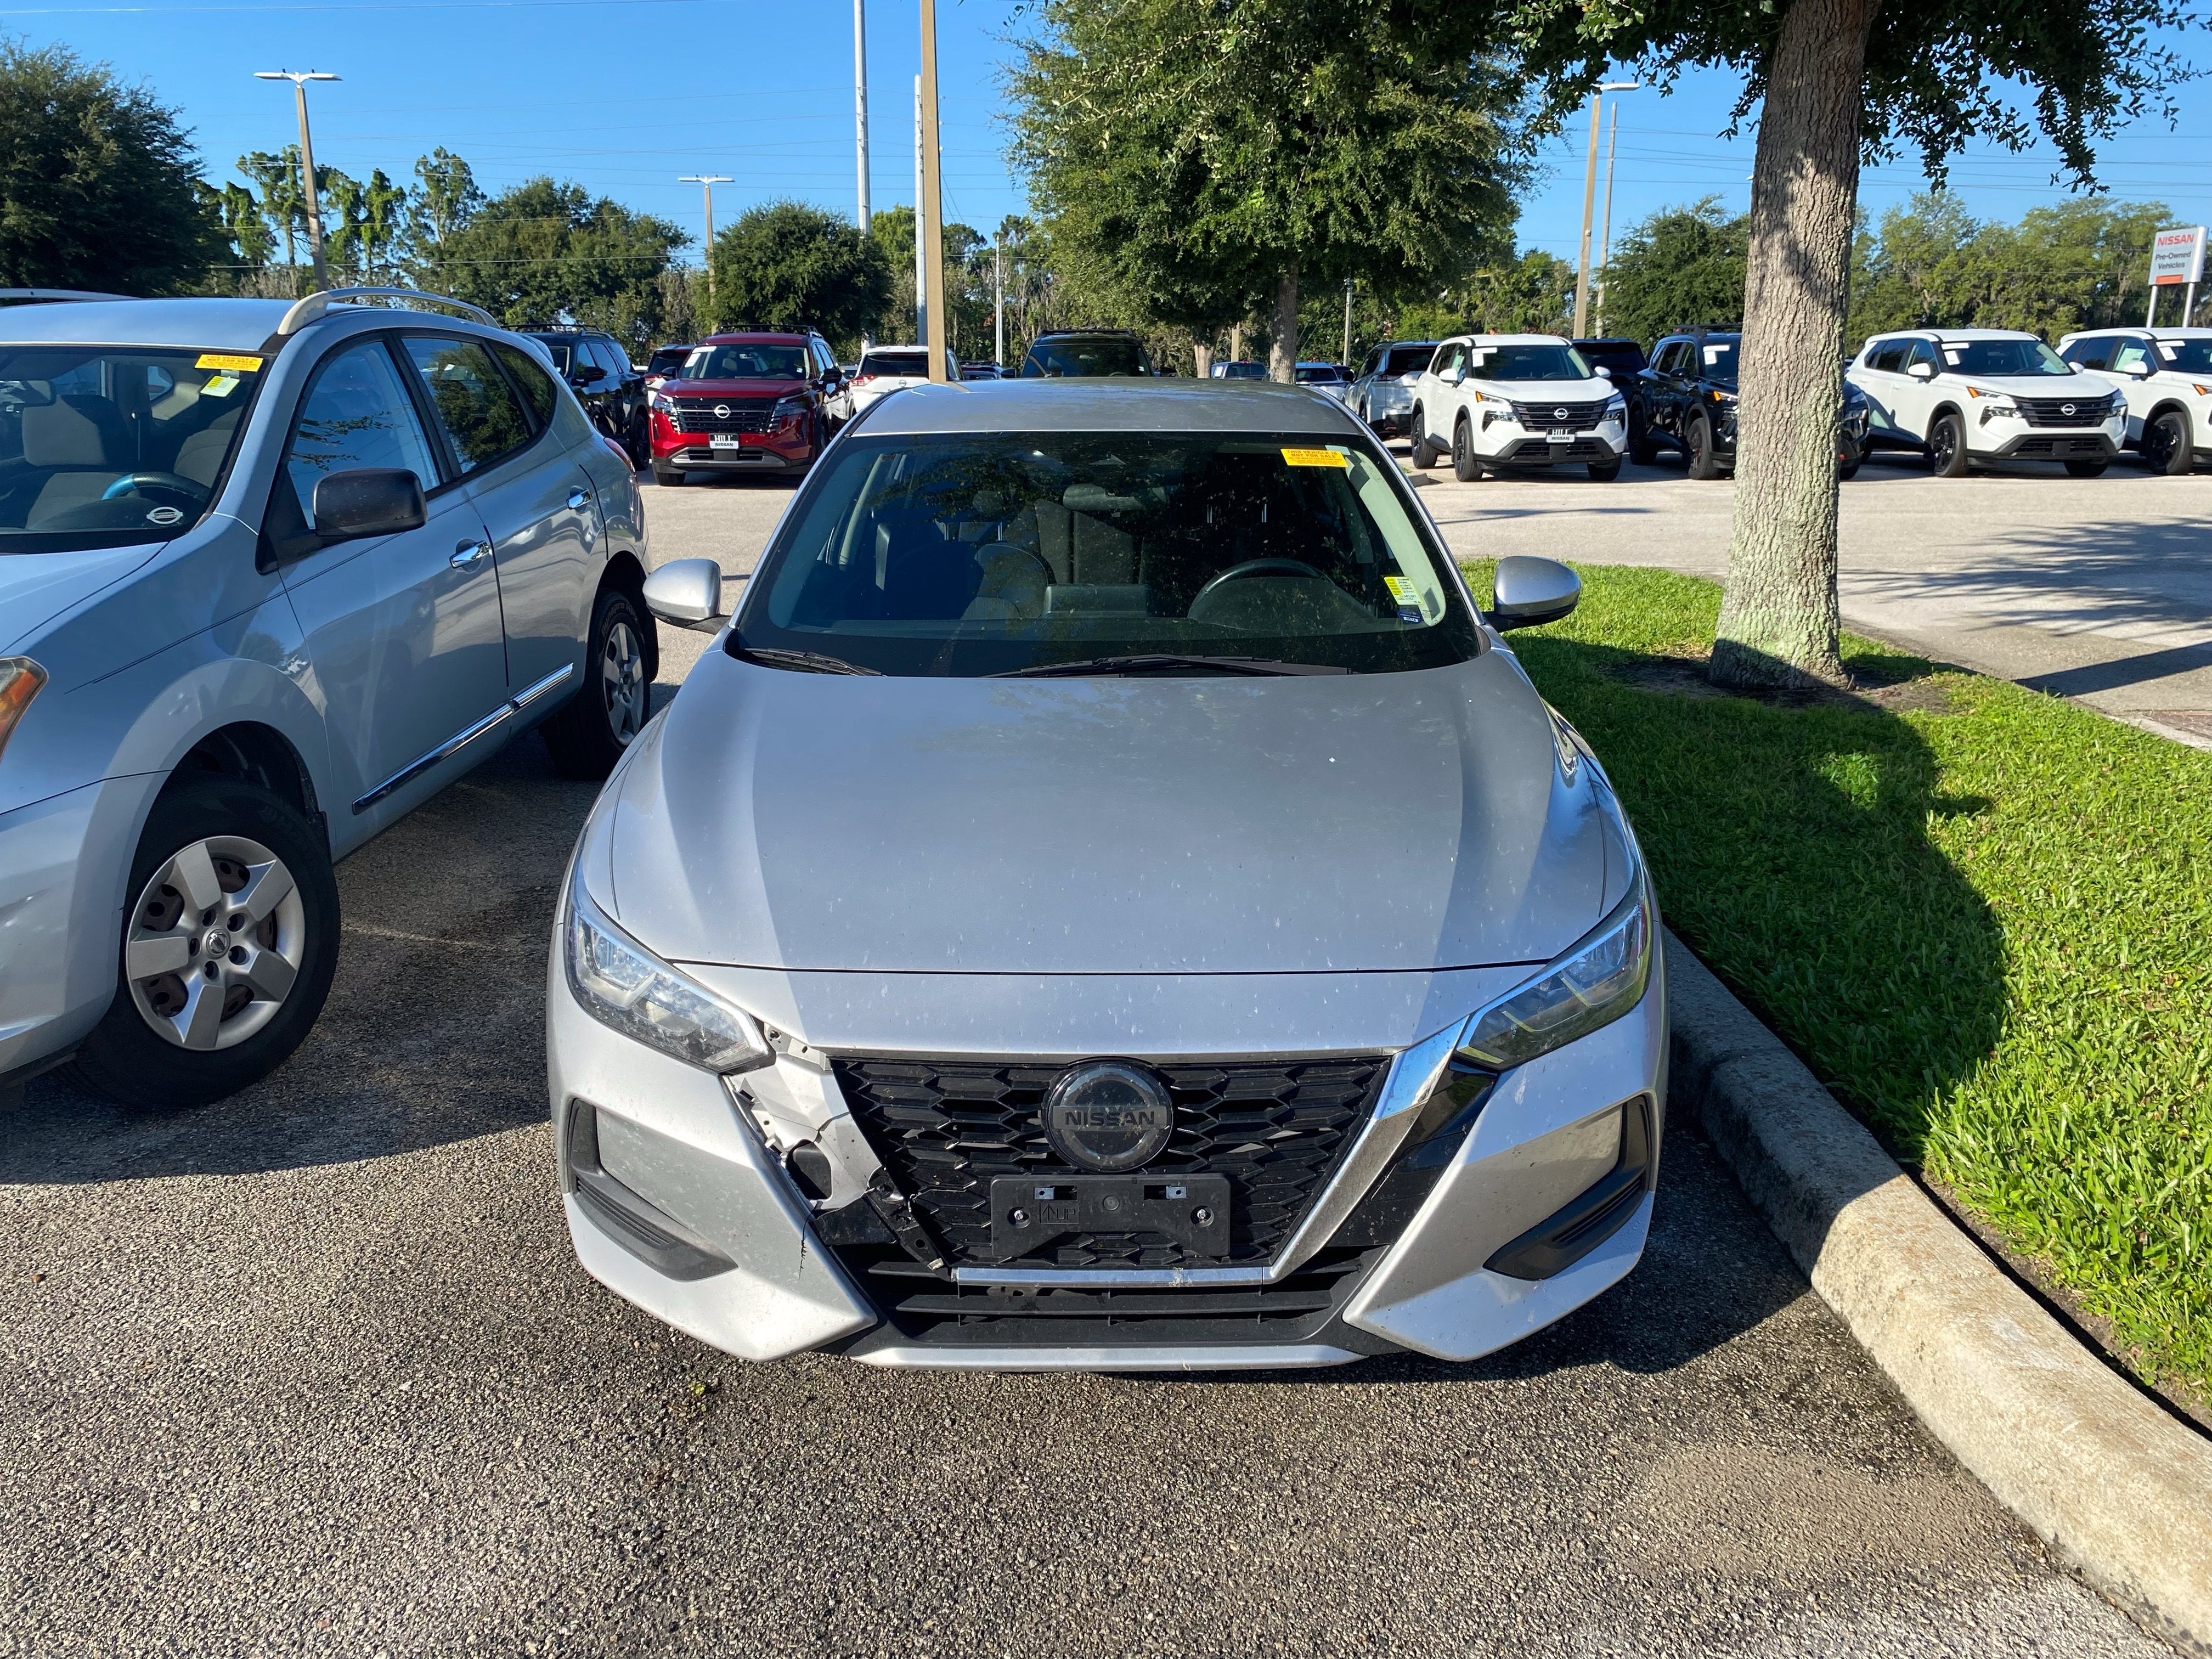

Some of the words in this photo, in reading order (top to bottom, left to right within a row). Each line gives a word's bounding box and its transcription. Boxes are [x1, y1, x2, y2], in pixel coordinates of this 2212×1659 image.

[2157, 234, 2194, 246] NISSAN
[2155, 251, 2192, 261] Pre-Owned
[1065, 1110, 1155, 1126] NISSAN
[1056, 1207, 1076, 1221] UP
